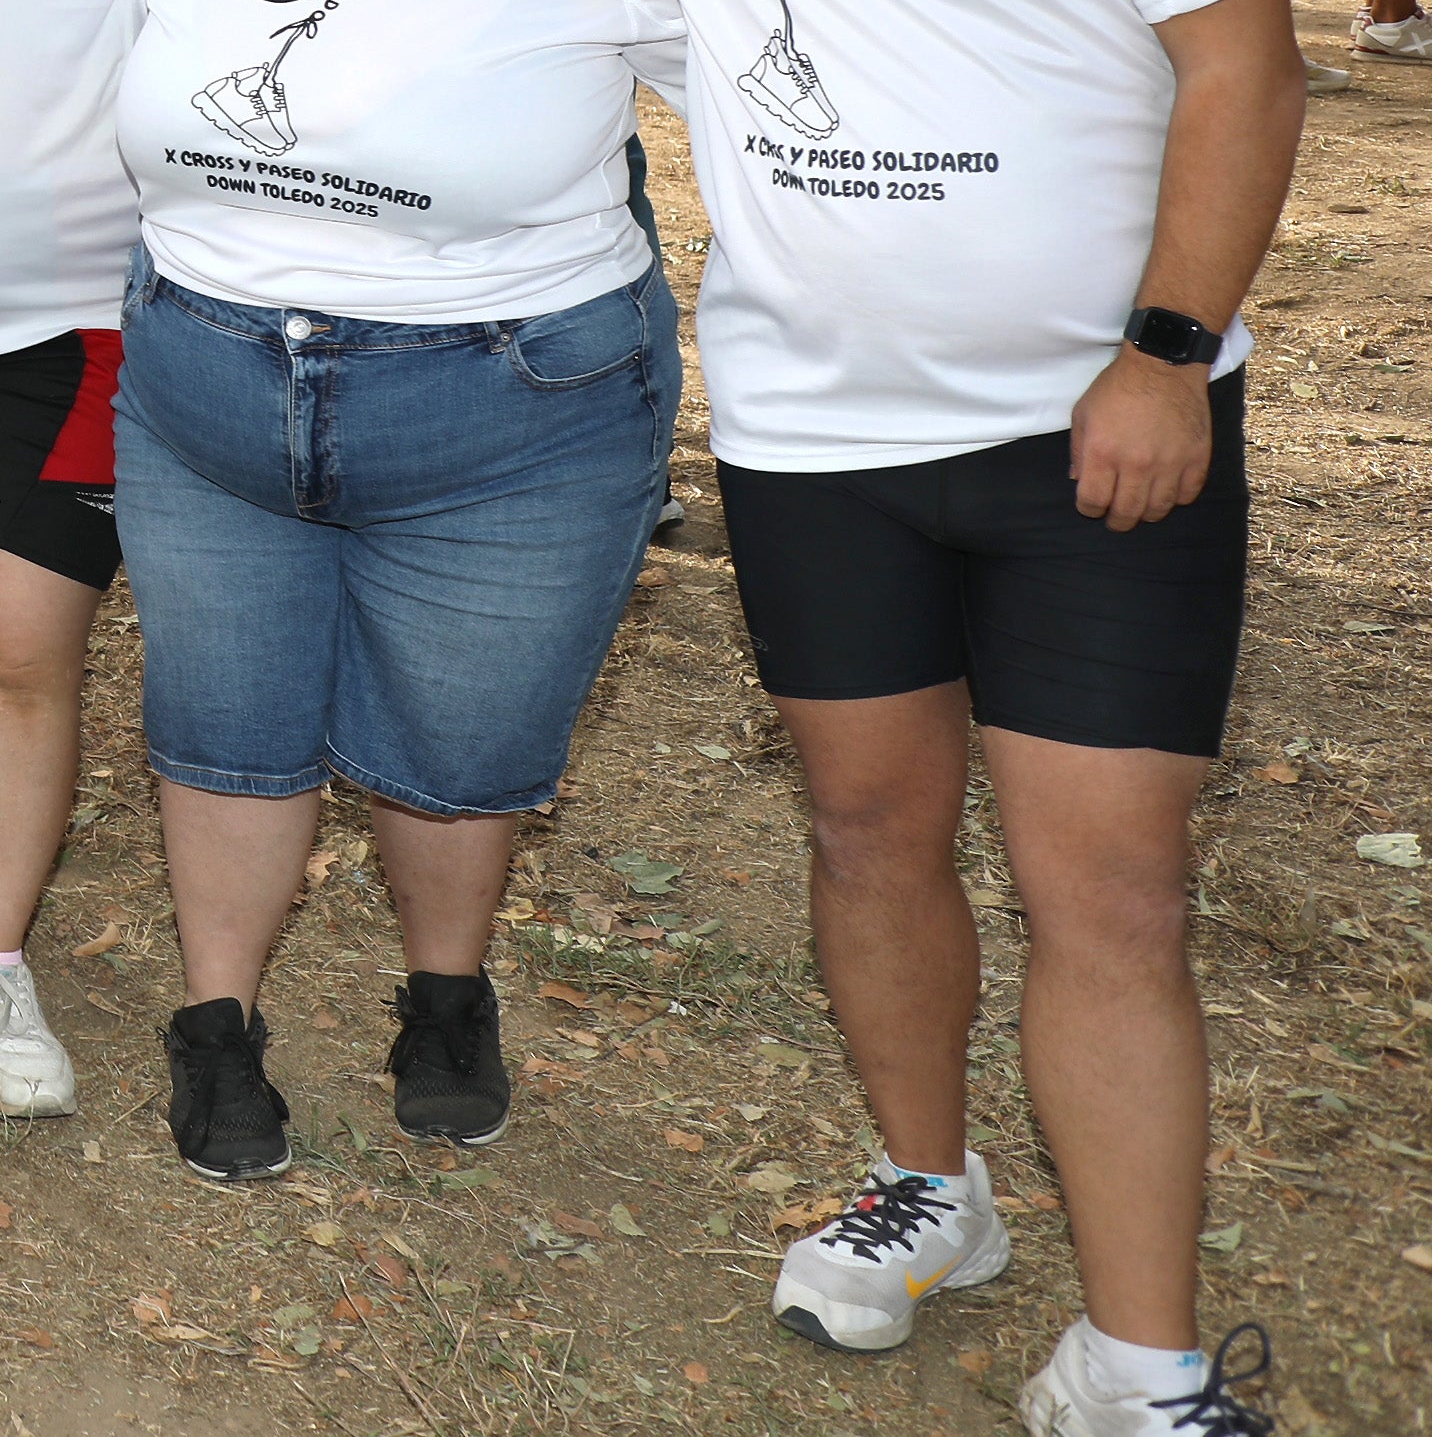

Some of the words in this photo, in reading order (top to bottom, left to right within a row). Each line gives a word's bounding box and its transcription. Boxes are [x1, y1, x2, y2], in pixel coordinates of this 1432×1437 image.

[743, 134, 757, 153] X
[790, 146, 804, 165] Y
[808, 150, 865, 172] PASEO
[872, 150, 1000, 174] SOLIDARIO
[164, 147, 177, 164] X
[180, 150, 235, 171] CROSS
[238, 159, 251, 173] Y
[257, 161, 316, 184] PASEO
[321, 172, 432, 212] SOLIDARIO
[206, 174, 256, 195] DOWN
[260, 181, 326, 208] TOLEDO
[329, 196, 380, 219] 2025
[809, 176, 881, 198] TOLEDO
[886, 181, 946, 202] 2025
